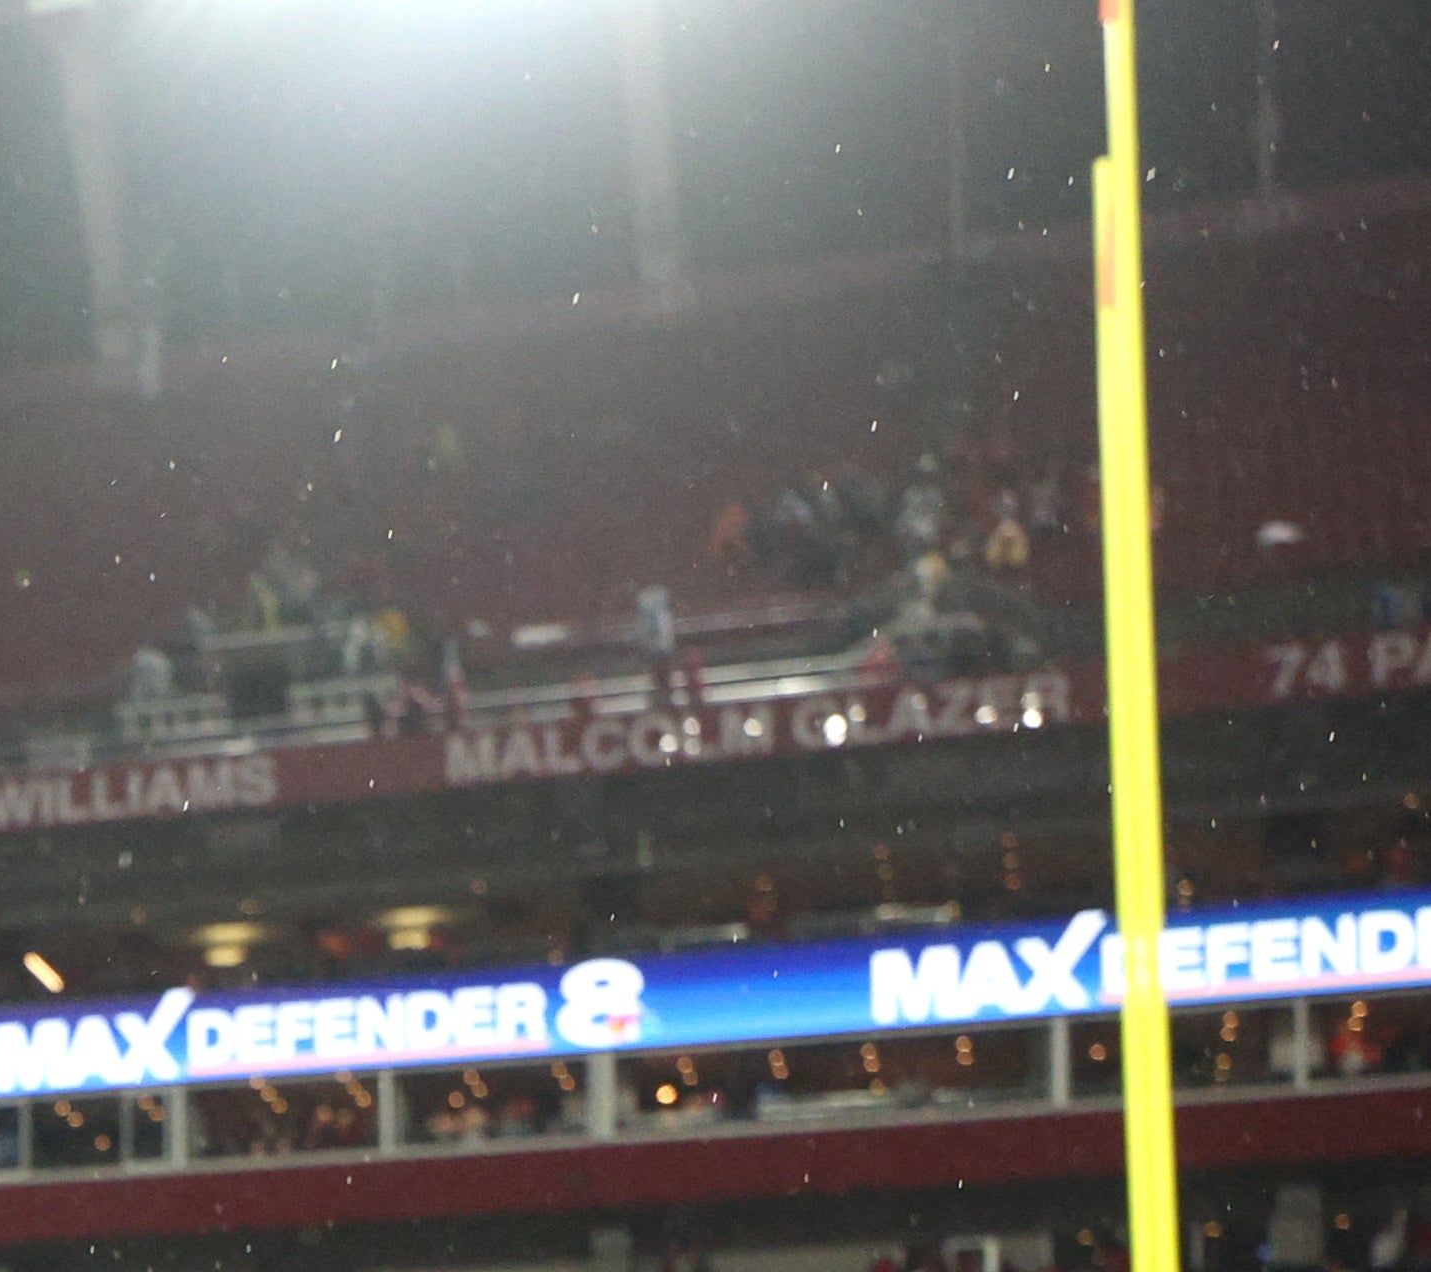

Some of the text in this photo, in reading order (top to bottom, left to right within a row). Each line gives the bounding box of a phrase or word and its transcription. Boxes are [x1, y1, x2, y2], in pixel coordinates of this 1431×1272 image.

[1269, 642, 1343, 699] 74
[445, 672, 1069, 784] MALCOLM GLAZER
[187, 981, 548, 1071] DEFENDER
[554, 956, 645, 1050] 8
[869, 907, 1108, 1024] MAX
